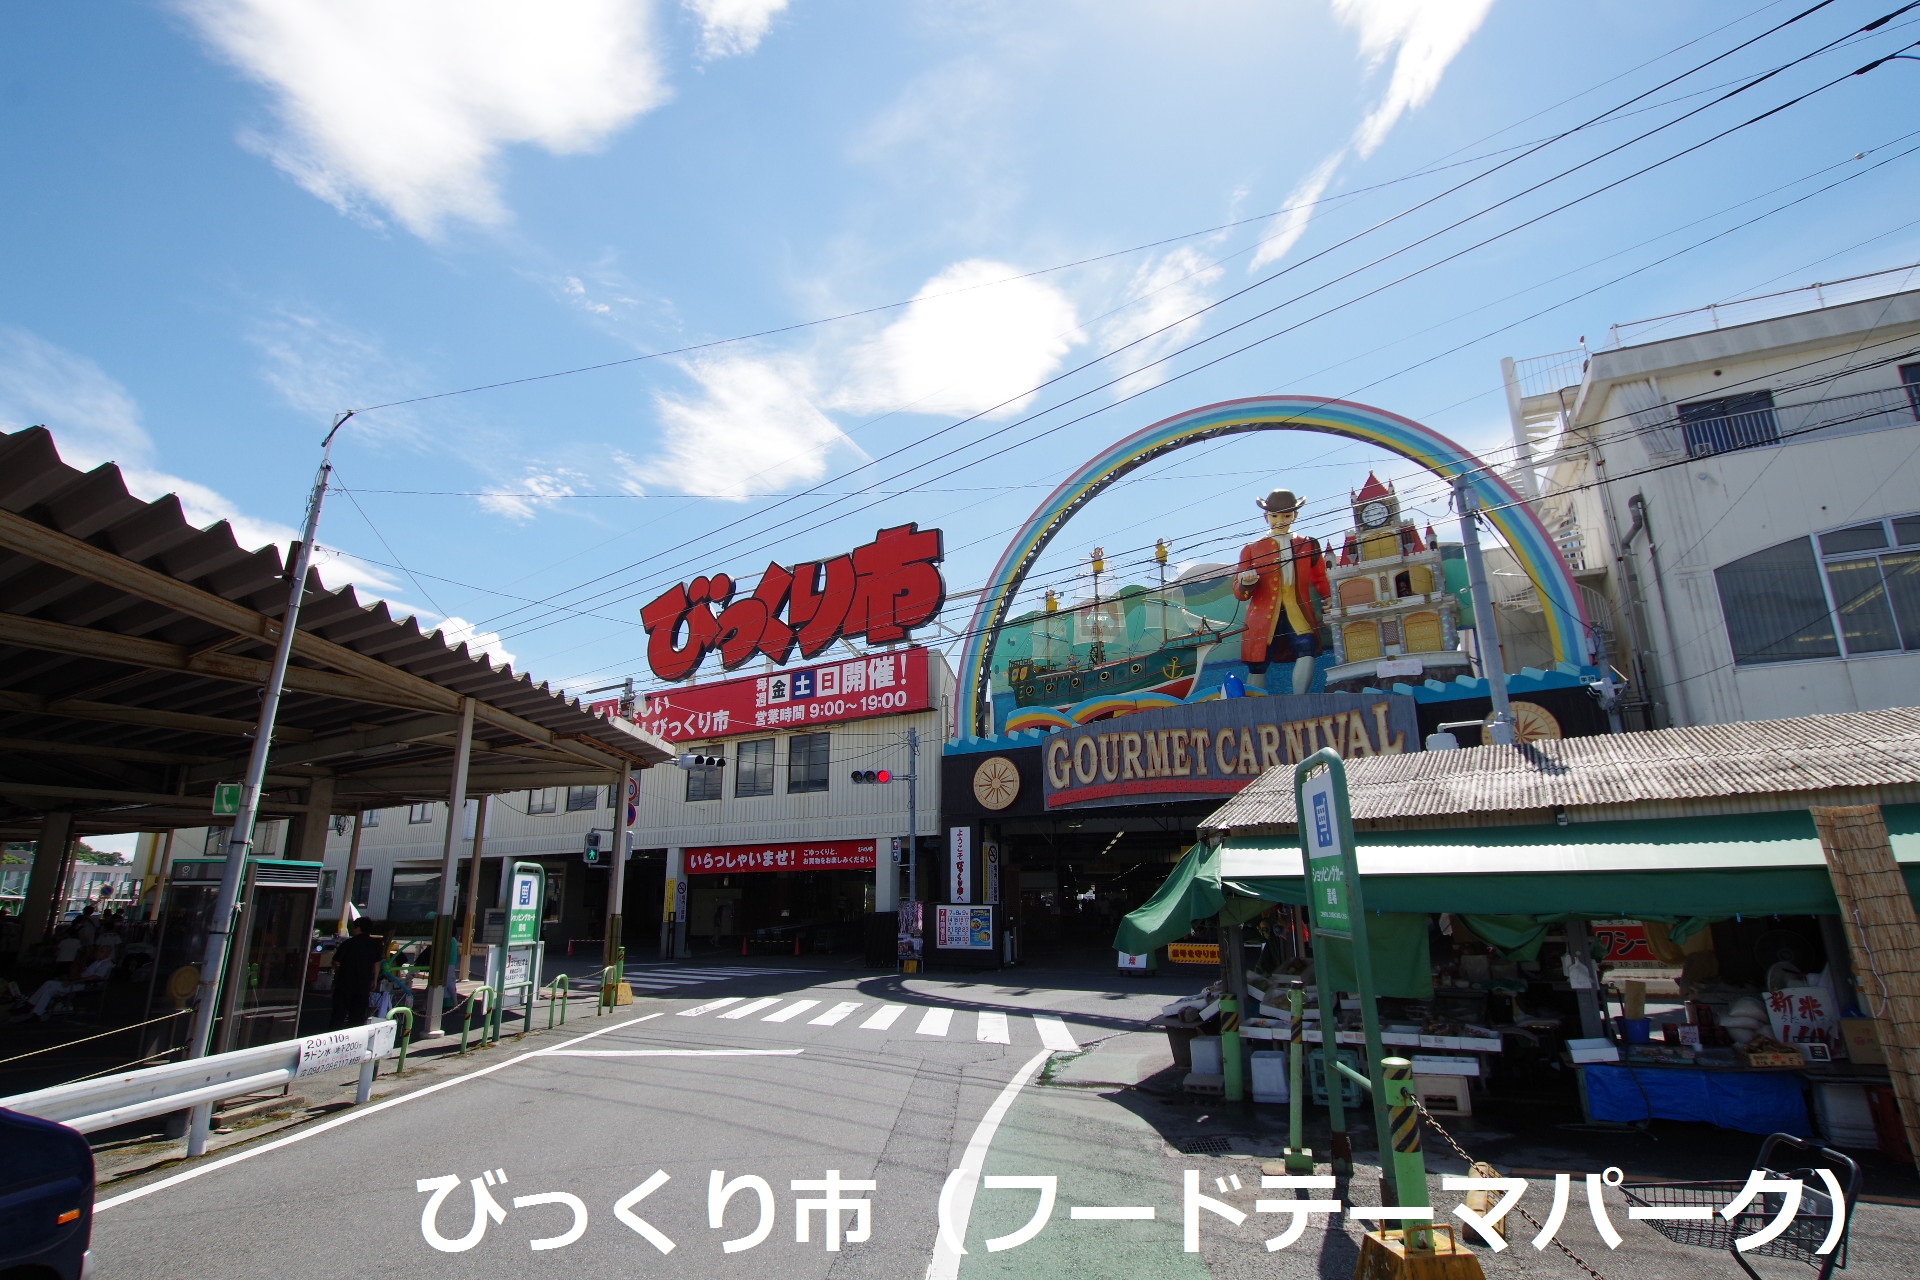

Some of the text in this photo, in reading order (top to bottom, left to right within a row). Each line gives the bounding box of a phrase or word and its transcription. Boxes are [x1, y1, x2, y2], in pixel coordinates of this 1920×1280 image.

[639, 521, 947, 683] びっくり市
[755, 704, 805, 727] 営業時間
[1045, 701, 1405, 791] GOURMET CARNIVAL
[690, 849, 796, 869] いらっしゃいませ!
[1769, 990, 1825, 1021] 新米
